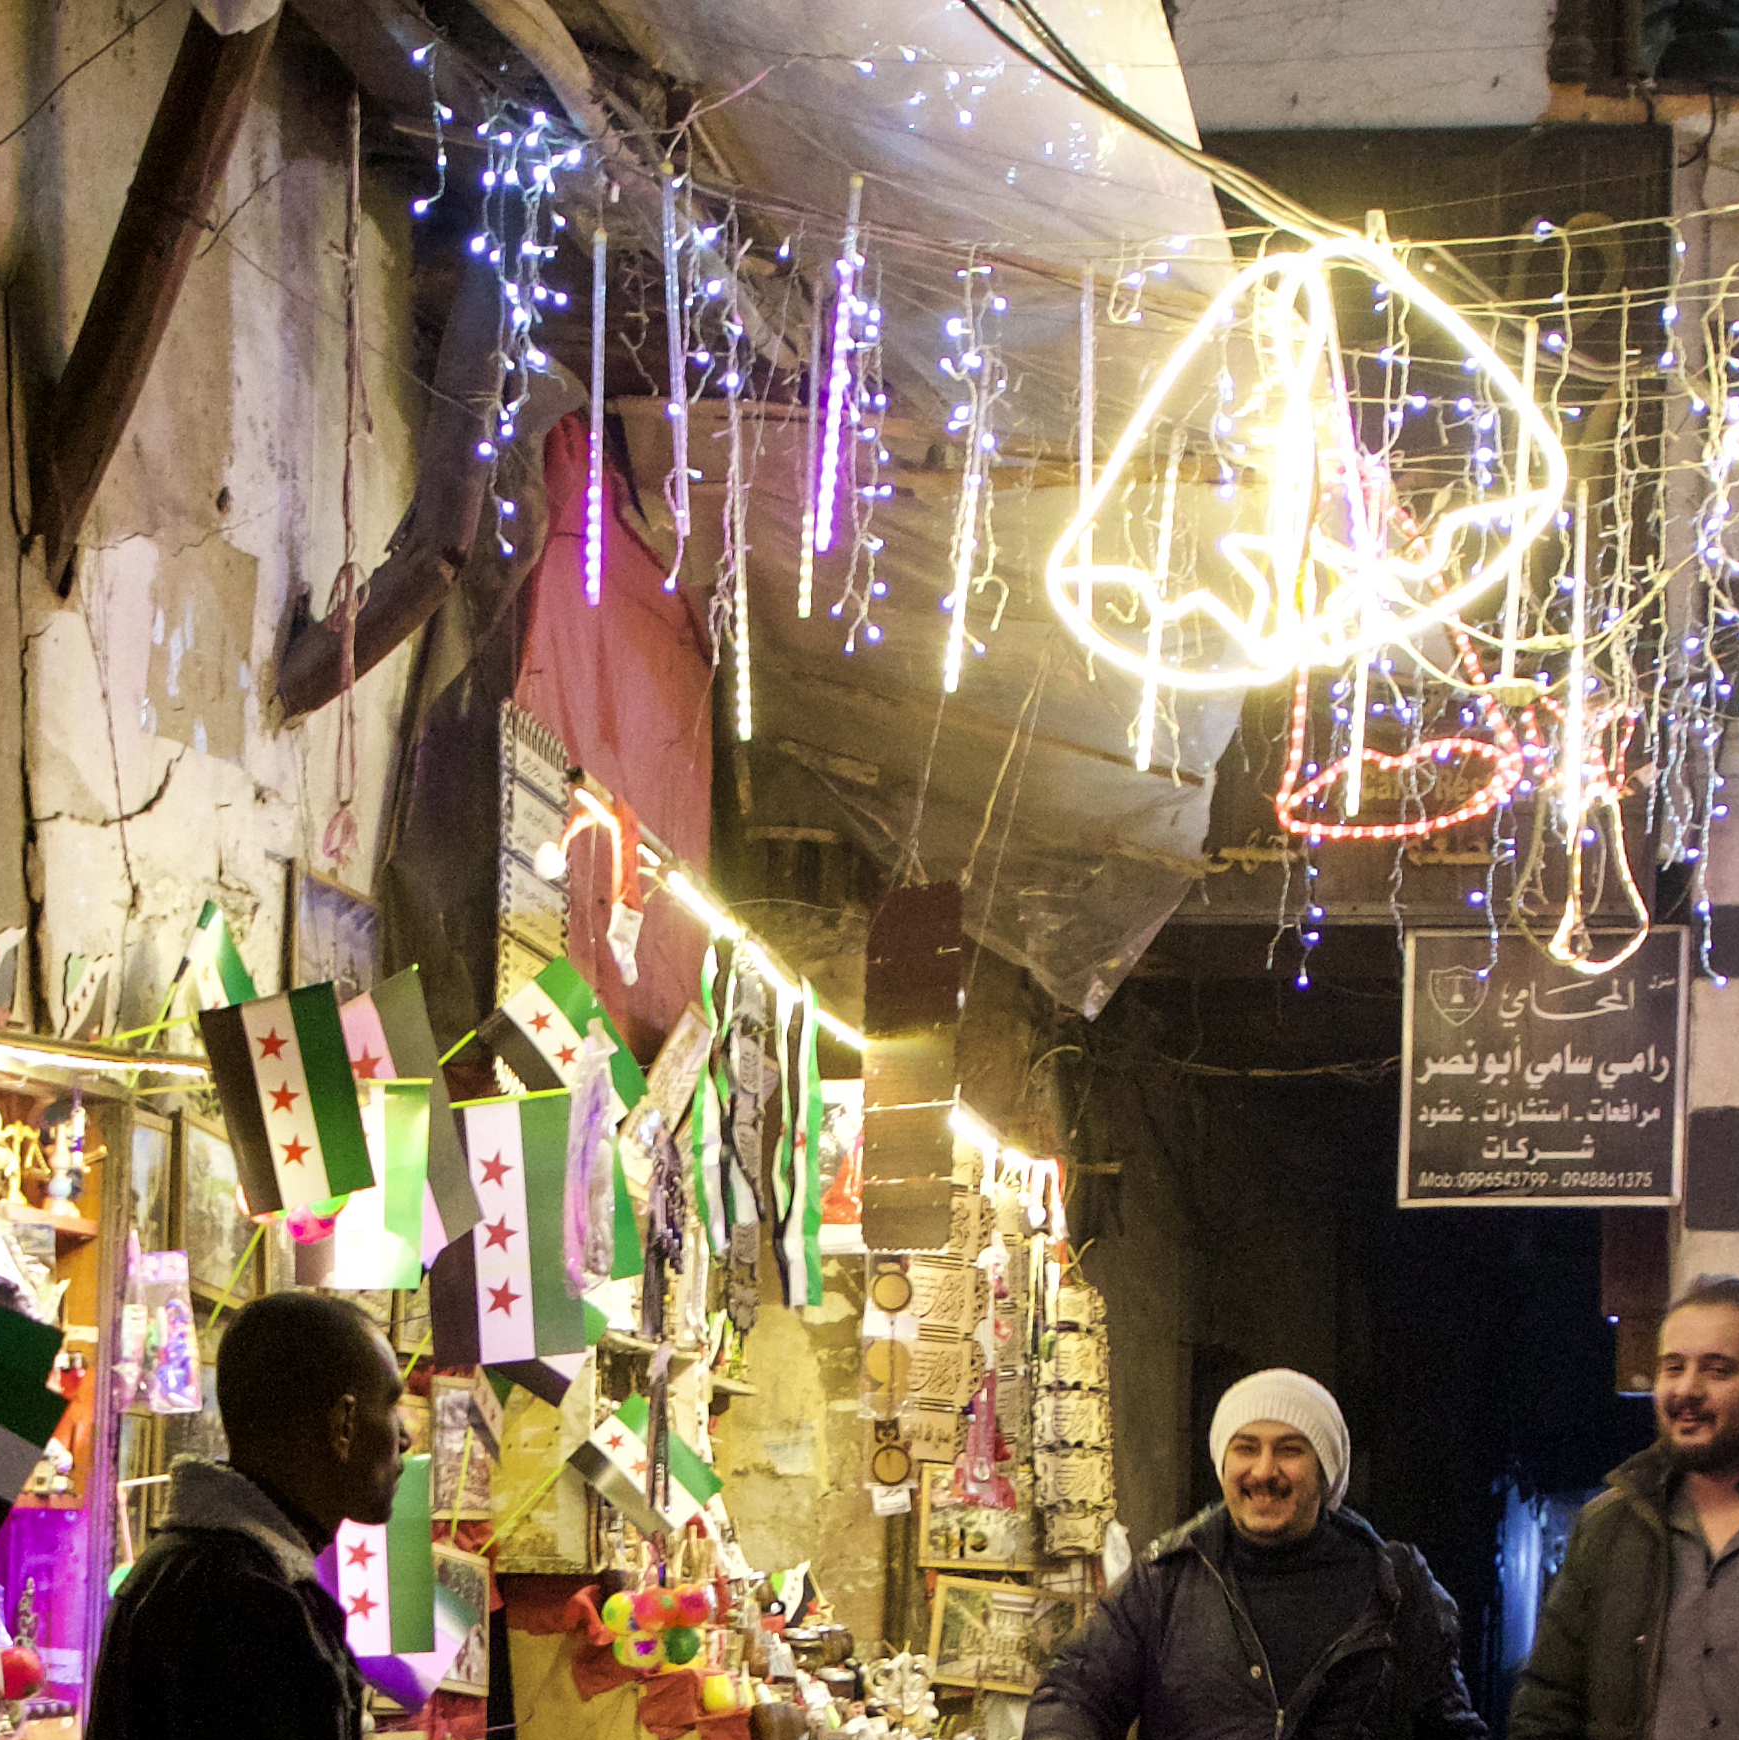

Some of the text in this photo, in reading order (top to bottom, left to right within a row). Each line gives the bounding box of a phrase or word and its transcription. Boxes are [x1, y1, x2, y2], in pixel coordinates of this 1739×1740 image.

[1497, 977, 1636, 1028] المحامي
[1415, 1038, 1480, 1085] نصر
[1524, 1042, 1594, 1091] سامي
[1597, 1043, 1670, 1089] رامي
[1417, 1098, 1465, 1128] عقود
[1482, 1097, 1570, 1127] استشارات
[1586, 1098, 1662, 1128] مرافعات
[1481, 1133, 1596, 1165] شركات
[1559, 1171, 1653, 1188] 0948861375
